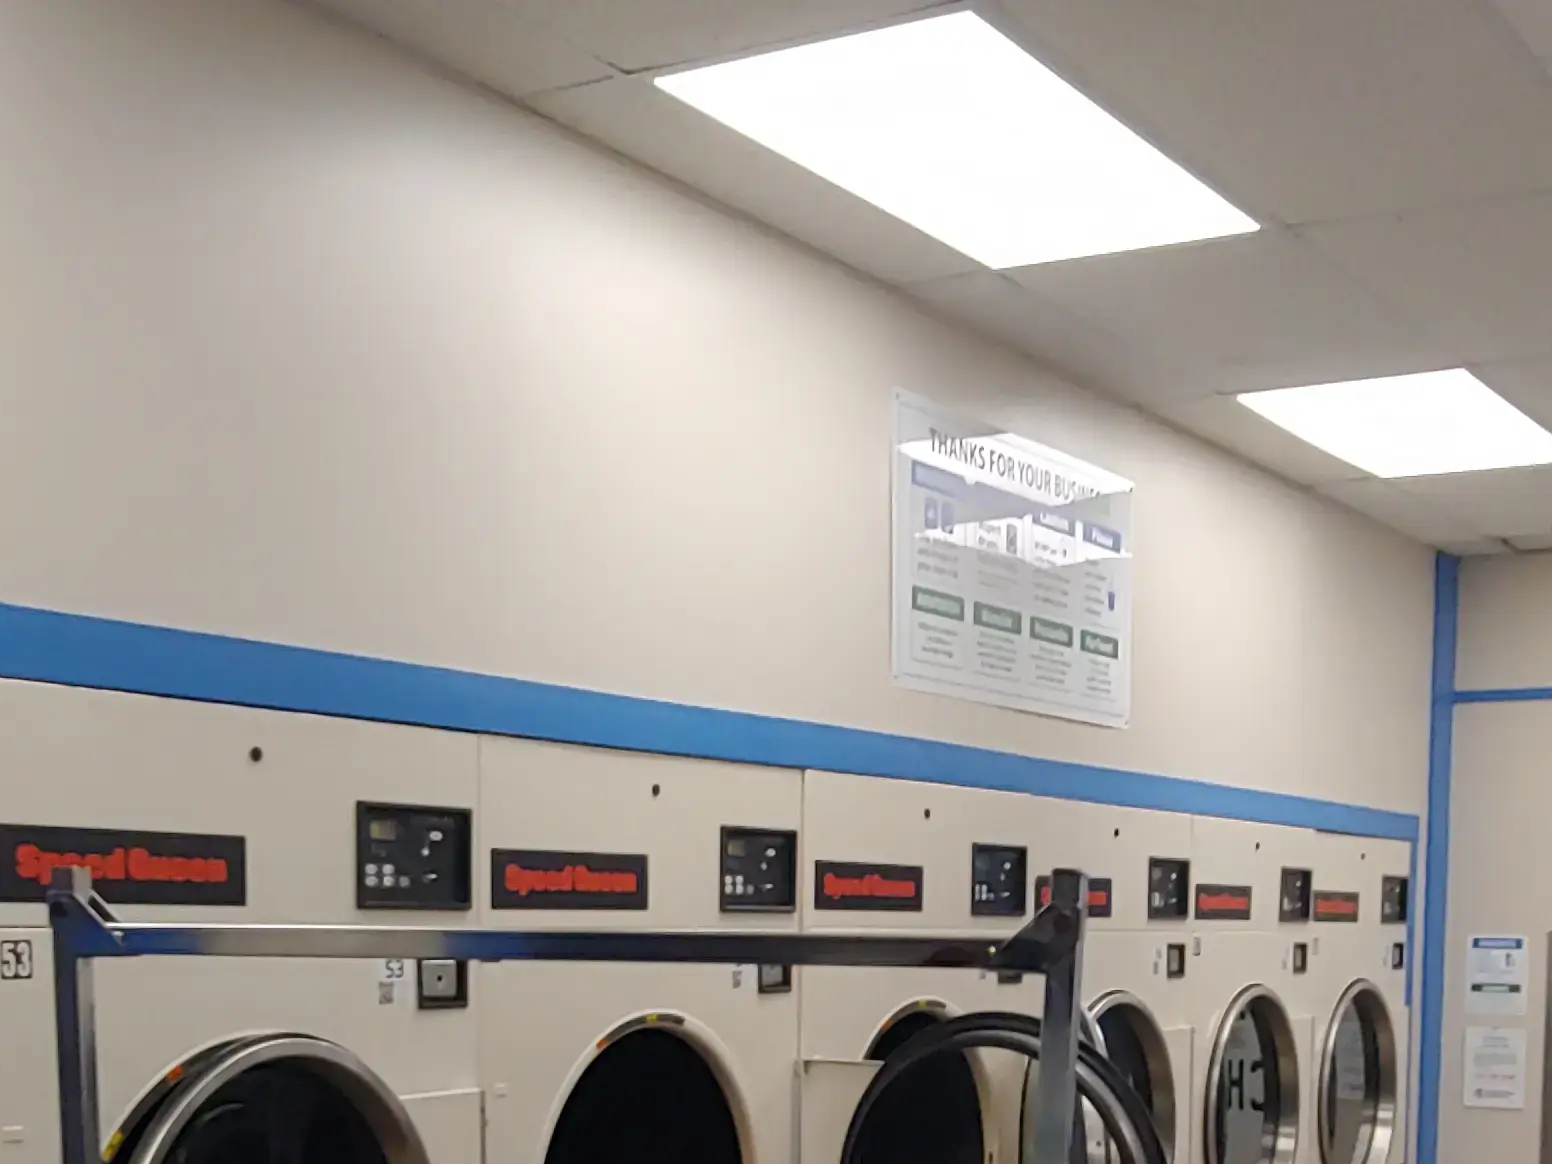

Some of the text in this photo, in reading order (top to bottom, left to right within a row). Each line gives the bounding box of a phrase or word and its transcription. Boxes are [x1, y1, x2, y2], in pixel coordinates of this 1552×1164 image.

[929, 427, 986, 470] THANKS
[989, 449, 1015, 481] FOR
[1018, 461, 1051, 495] YOUR
[0, 940, 33, 979] 53
[385, 958, 405, 979] 53
